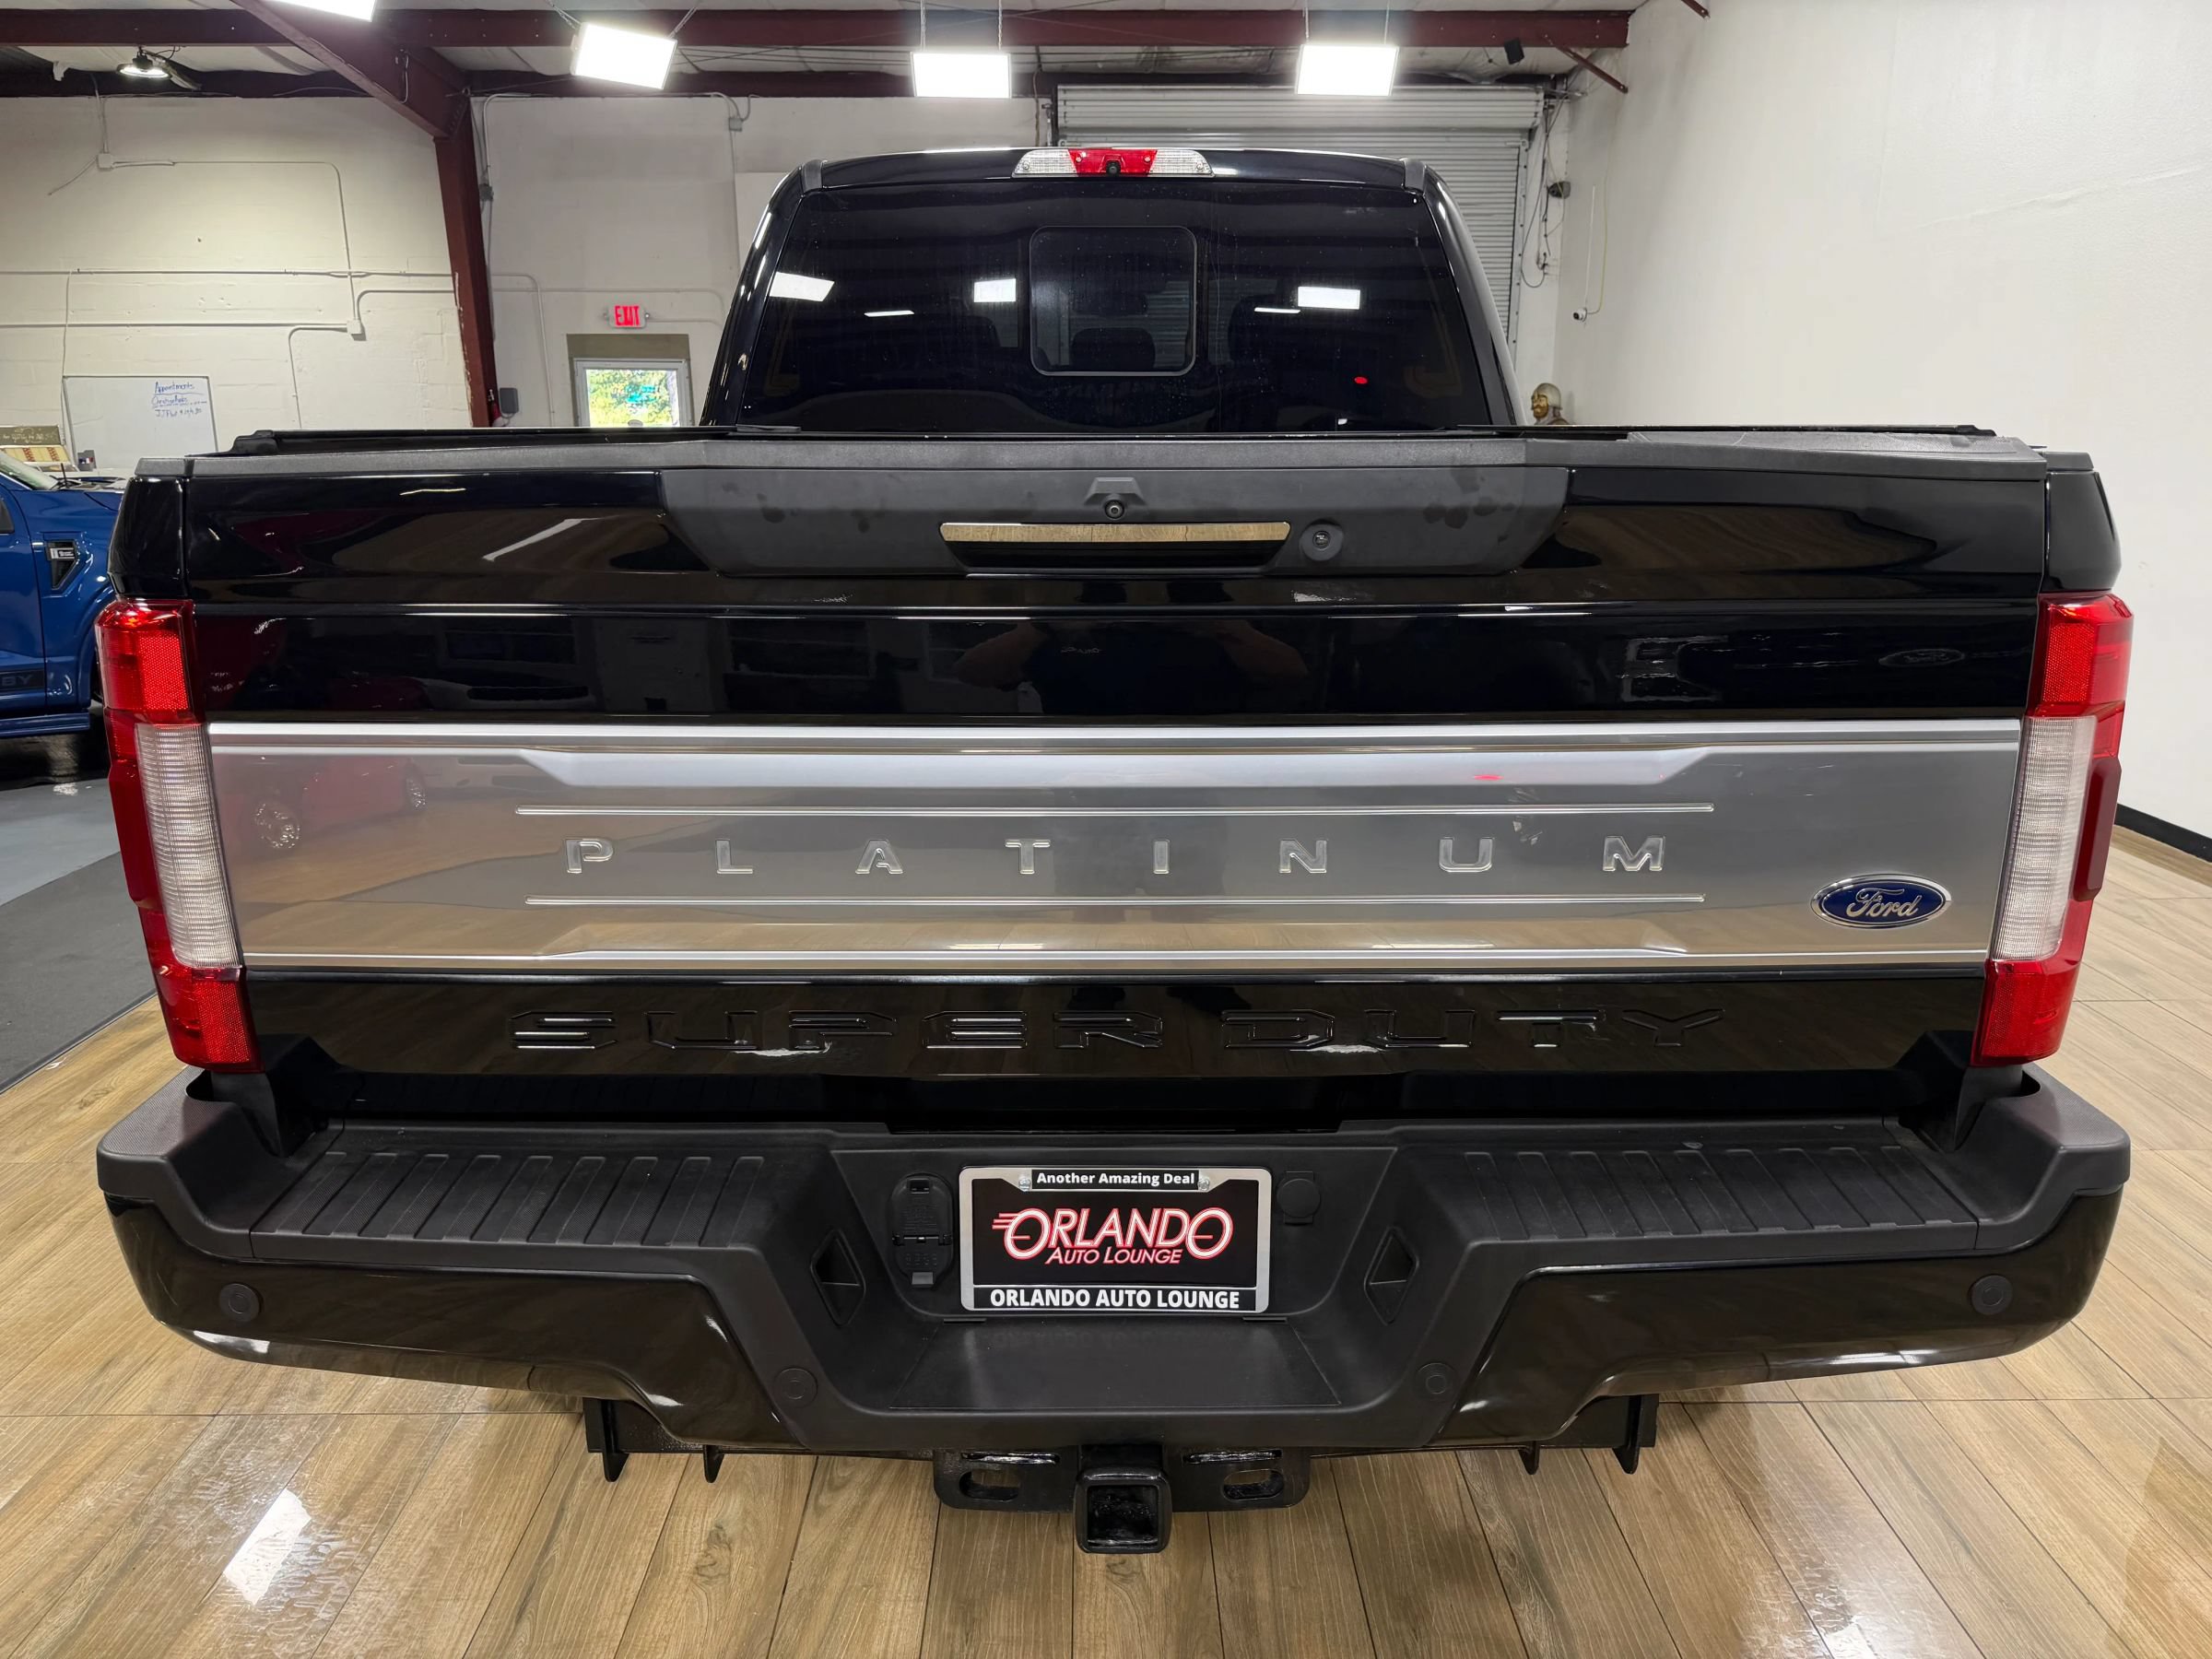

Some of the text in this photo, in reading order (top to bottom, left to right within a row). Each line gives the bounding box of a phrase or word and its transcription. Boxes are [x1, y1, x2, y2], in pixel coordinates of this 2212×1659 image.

[615, 305, 640, 326] EXIT
[564, 836, 1665, 875] PLATINUM
[1846, 888, 1922, 918] Ford
[510, 1009, 1724, 1053] SUPER DUTY
[1036, 1172, 1194, 1186] Another Amazing Deal
[1004, 1207, 1234, 1260] ORLANDO
[1044, 1247, 1183, 1265] AUTO LOUNGE
[990, 1288, 1240, 1309] ORLANDO AUTO LOUNGE
